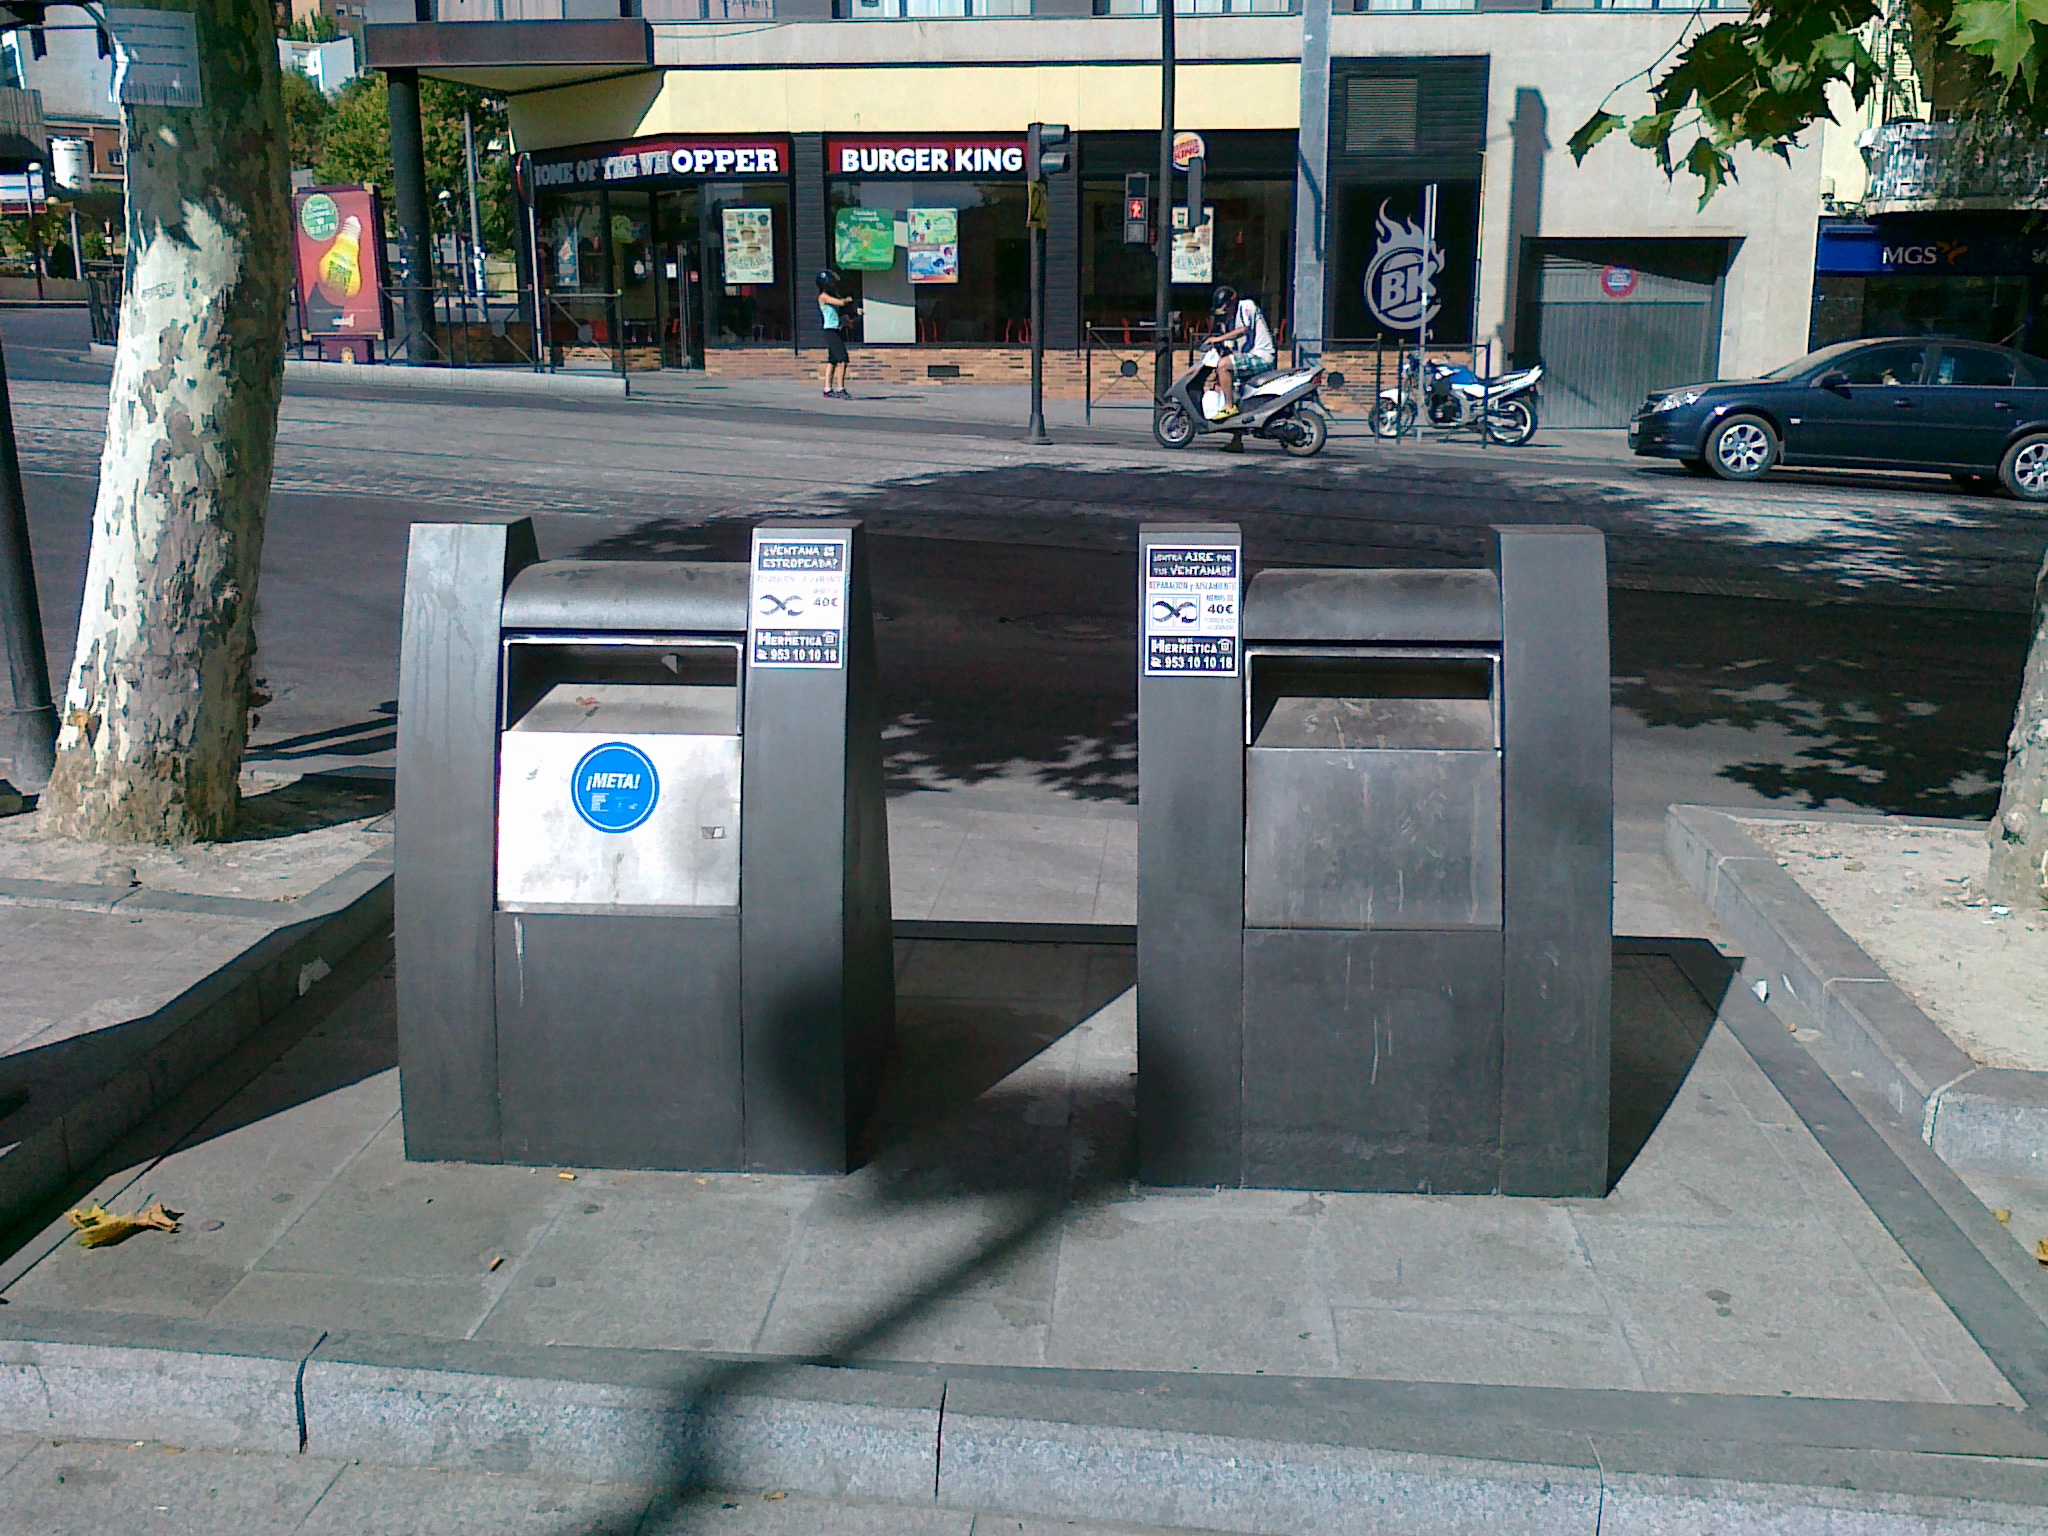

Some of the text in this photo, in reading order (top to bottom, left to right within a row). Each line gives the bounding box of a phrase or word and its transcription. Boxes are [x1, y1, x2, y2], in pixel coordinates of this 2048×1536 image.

[576, 158, 599, 182] OF
[601, 154, 638, 180] THE
[842, 147, 1023, 173] BURGER KING
[1882, 245, 1938, 265] MGS
[1380, 260, 1438, 311] BK
[1185, 551, 1214, 563] AIRE
[1207, 604, 1234, 614] 40€
[770, 648, 837, 662] 953 10 10 18
[1164, 656, 1233, 669] 953 10 10 18
[585, 772, 641, 791] ¡META!
